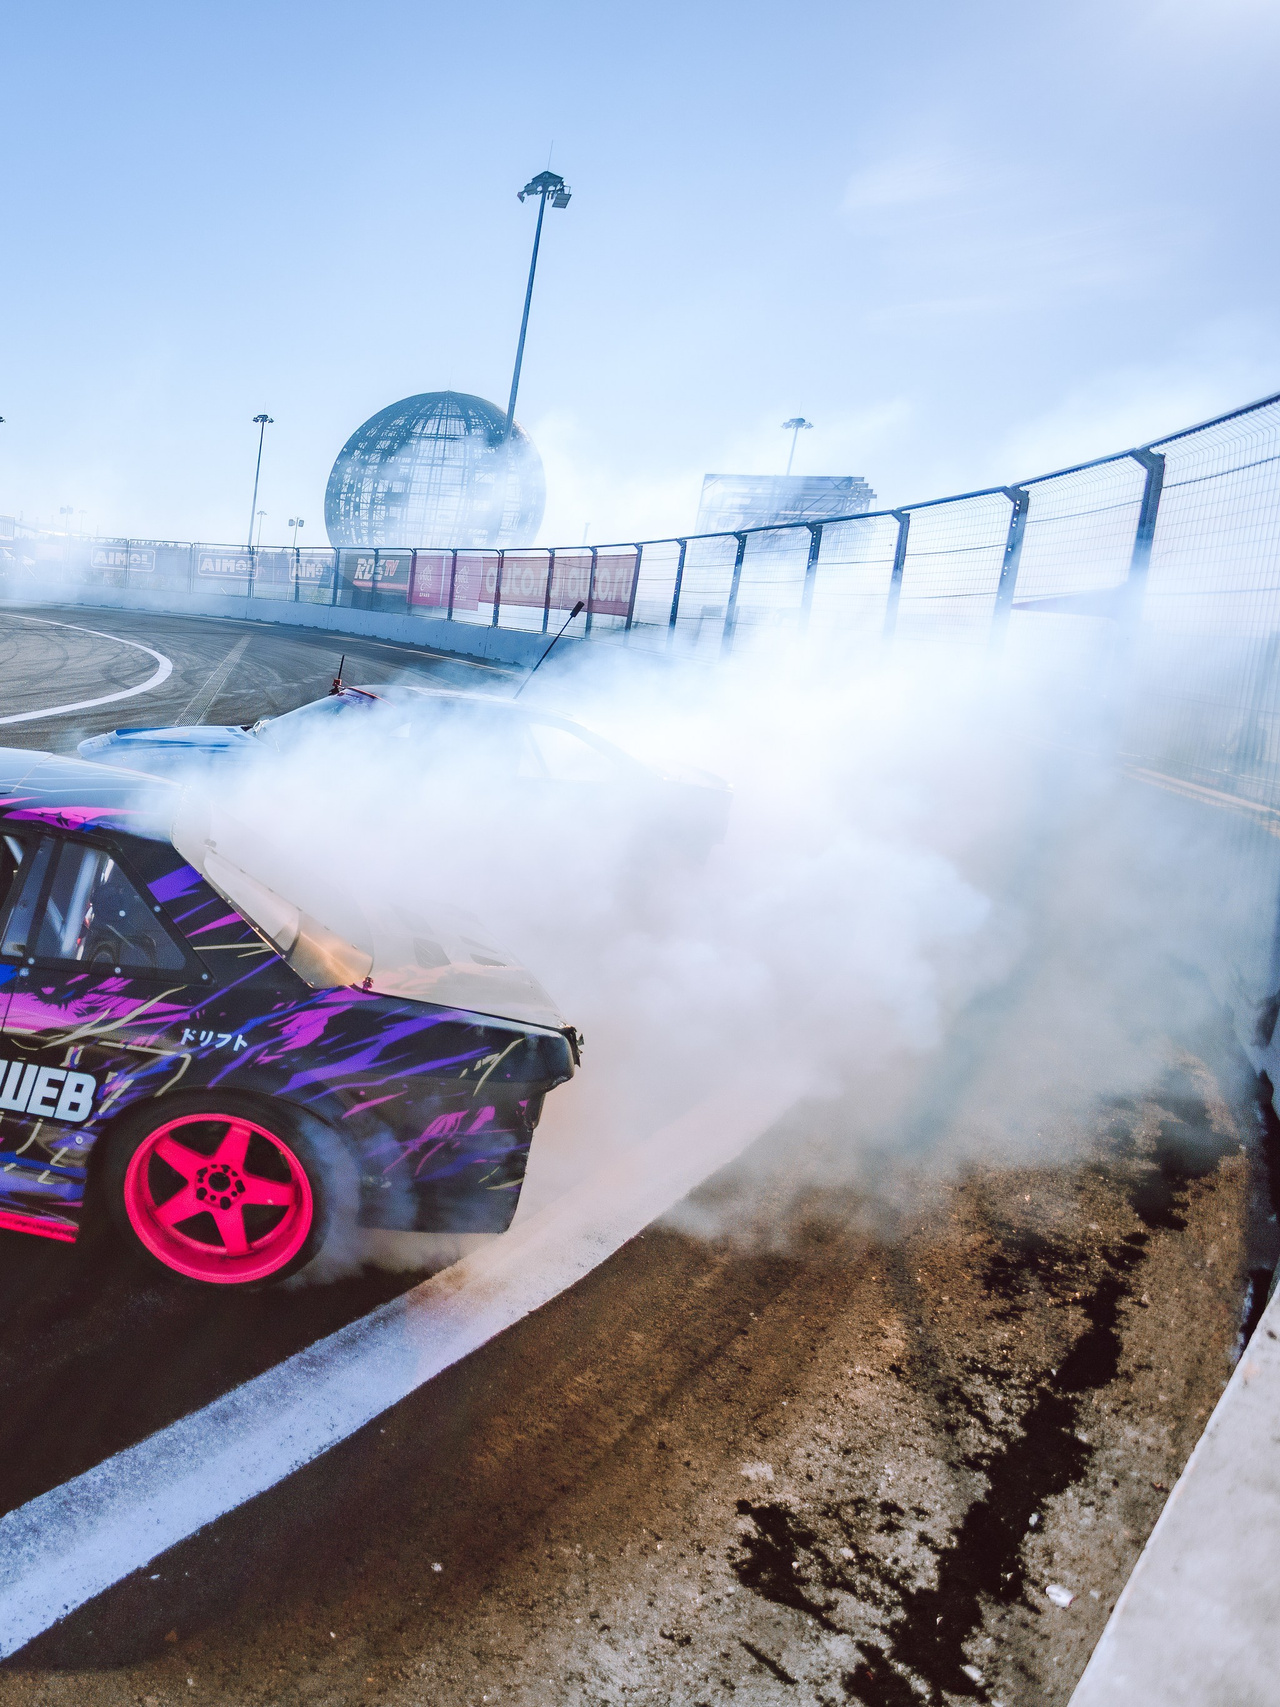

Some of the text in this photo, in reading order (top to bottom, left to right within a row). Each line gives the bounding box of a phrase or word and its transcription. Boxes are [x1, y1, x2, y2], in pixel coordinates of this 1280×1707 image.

[94, 551, 152, 568] AIMOL
[292, 563, 327, 578] AIMO
[485, 563, 561, 598] auto.ru
[180, 1028, 248, 1051] ドリフト
